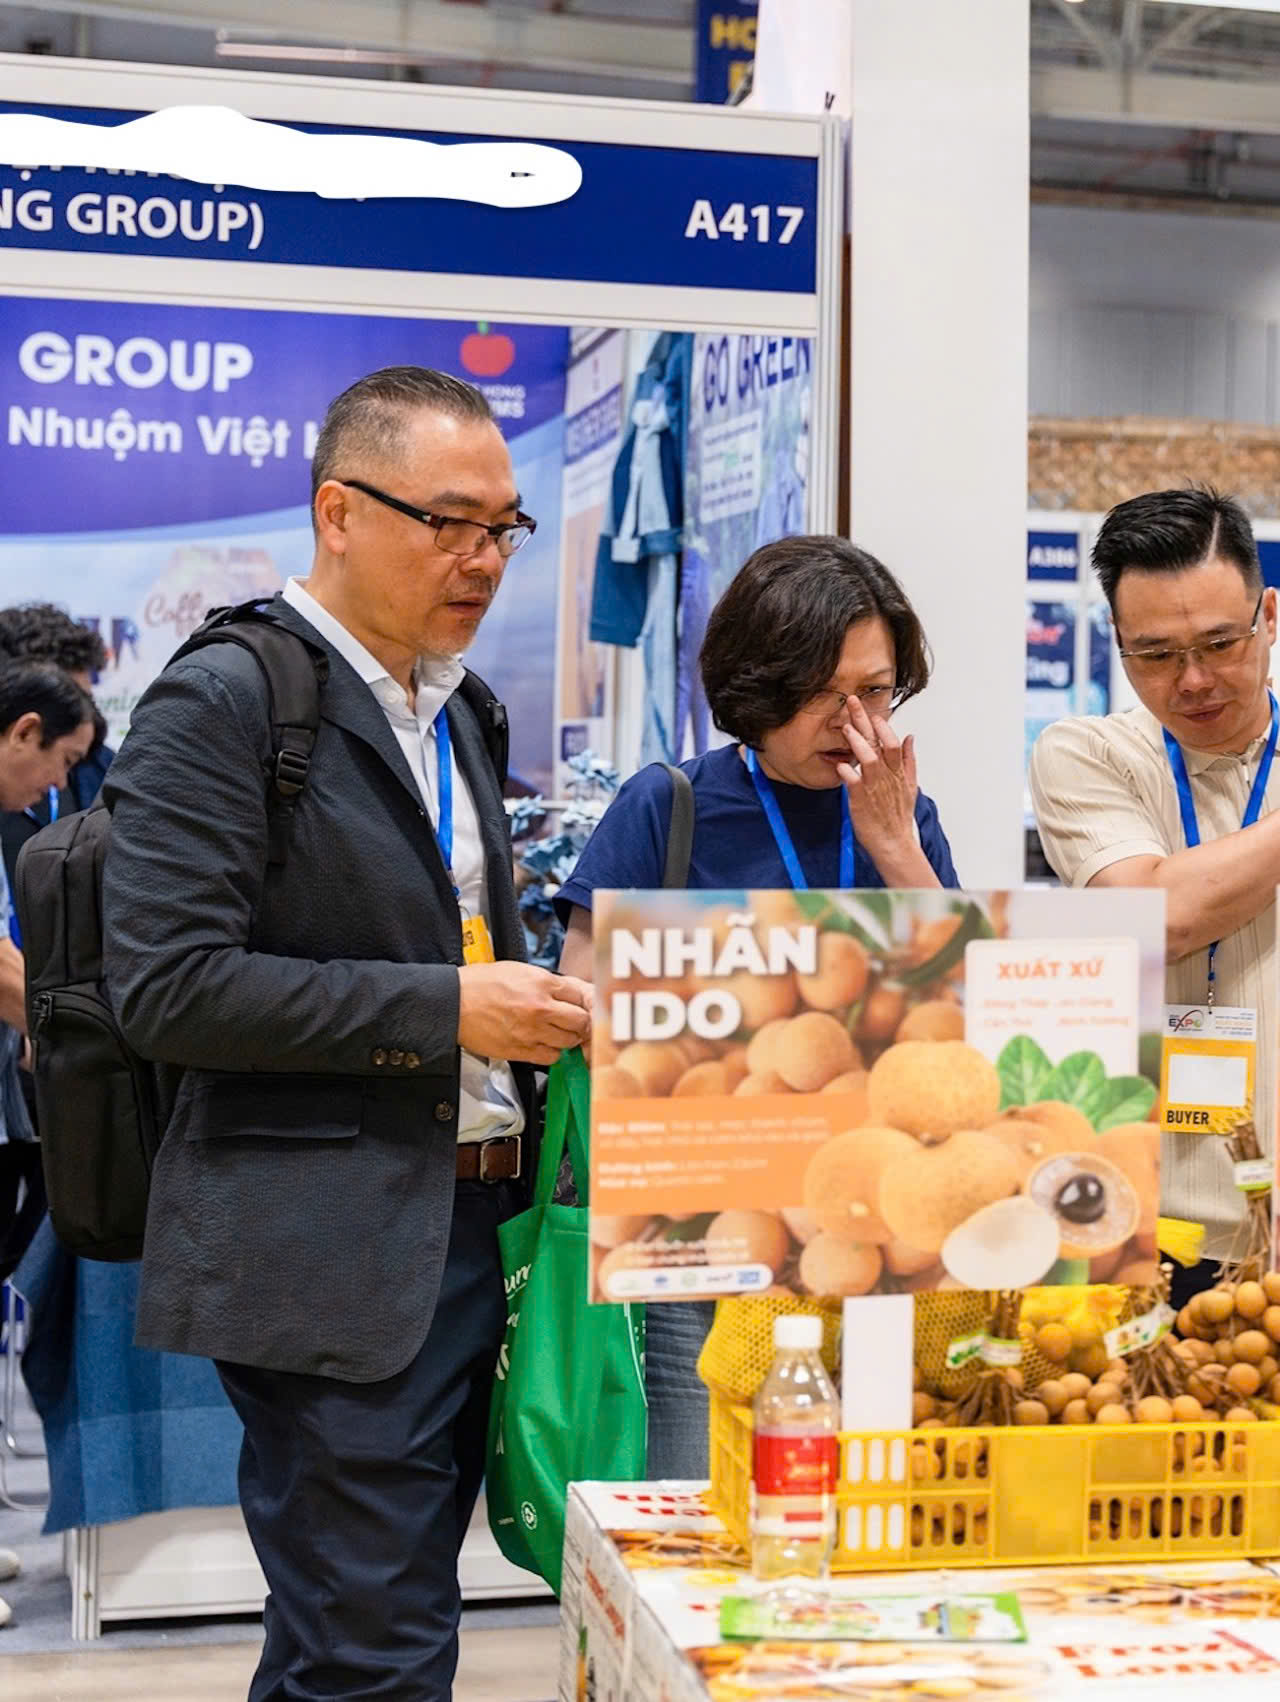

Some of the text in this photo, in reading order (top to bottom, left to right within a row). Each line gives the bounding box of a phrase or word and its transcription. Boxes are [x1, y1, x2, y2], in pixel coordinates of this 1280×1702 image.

[66, 192, 264, 249] GROUP)
[685, 199, 804, 244] A417
[19, 331, 254, 392] GROUP
[8, 405, 183, 462] Nhuộm
[197, 414, 291, 468] Việt
[611, 912, 818, 979] NHÃN
[611, 988, 743, 1042] IDO
[1167, 1110, 1210, 1125] BUYER
